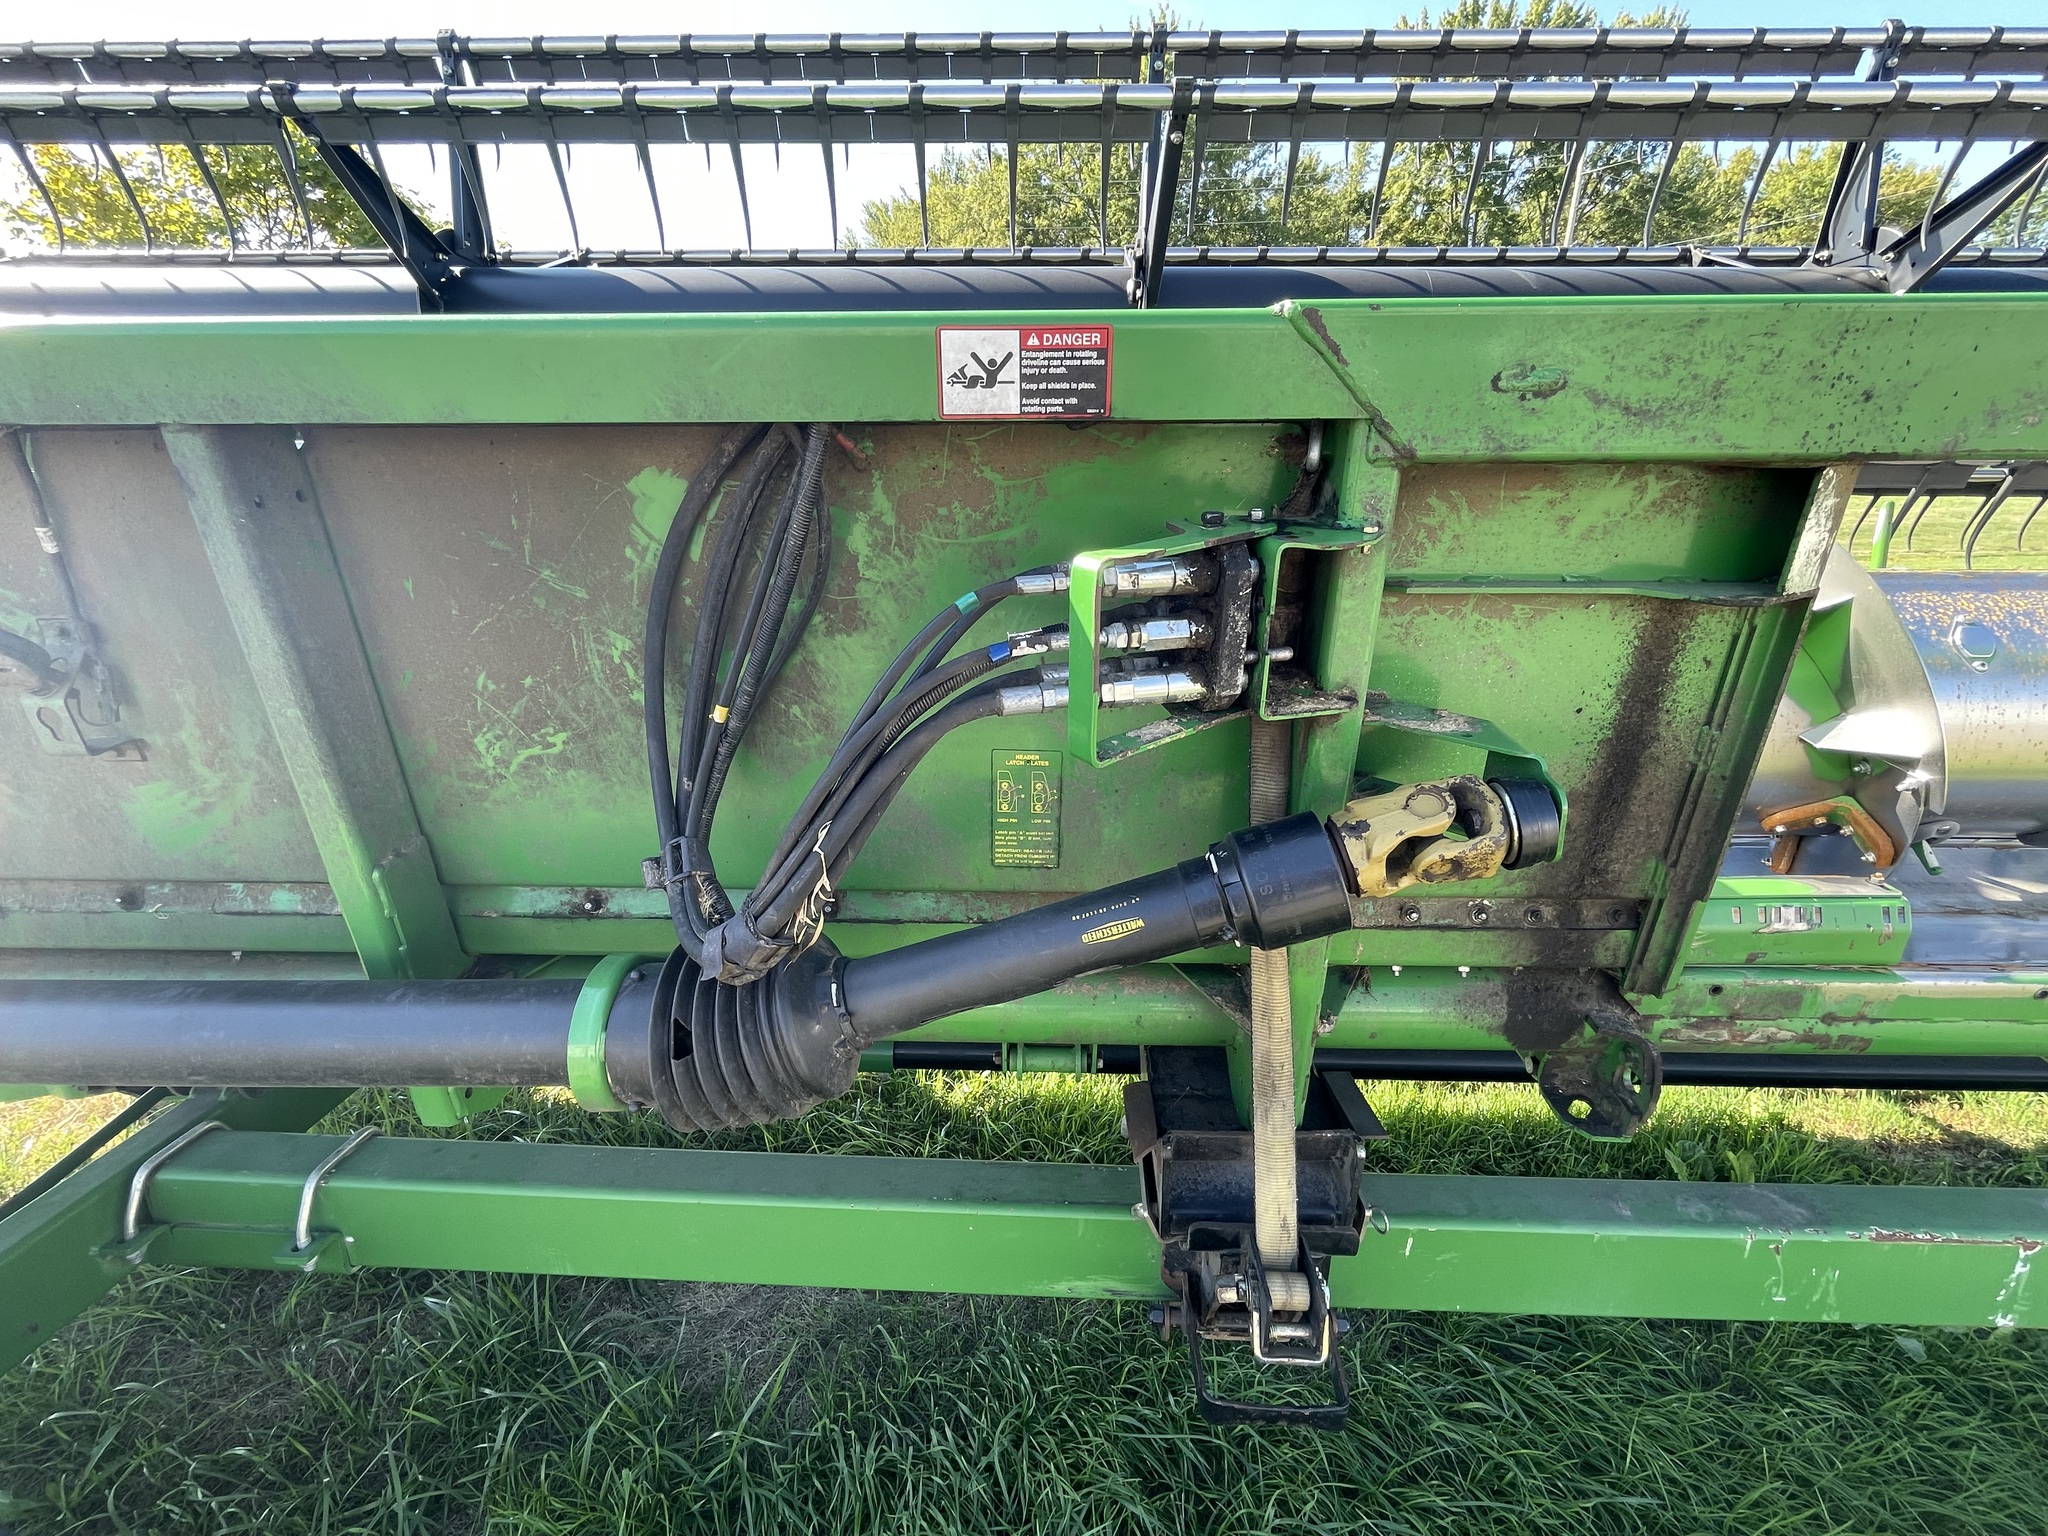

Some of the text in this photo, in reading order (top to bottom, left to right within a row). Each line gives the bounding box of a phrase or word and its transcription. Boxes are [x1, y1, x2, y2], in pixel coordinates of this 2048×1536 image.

[1043, 333, 1100, 345] DANGER
[1021, 350, 1064, 359] Entanglement
[1073, 350, 1098, 359] rotating
[1082, 358, 1105, 366] serious
[1021, 366, 1040, 375] injury
[1048, 366, 1068, 374] death.
[1021, 382, 1038, 391] Keep
[1078, 382, 1097, 391] place.
[1021, 397, 1040, 405] Avoid
[1041, 397, 1064, 405] contact
[1021, 405, 1064, 413] rotating parts.
[1081, 918, 1146, 943] WALTERSCHEID
